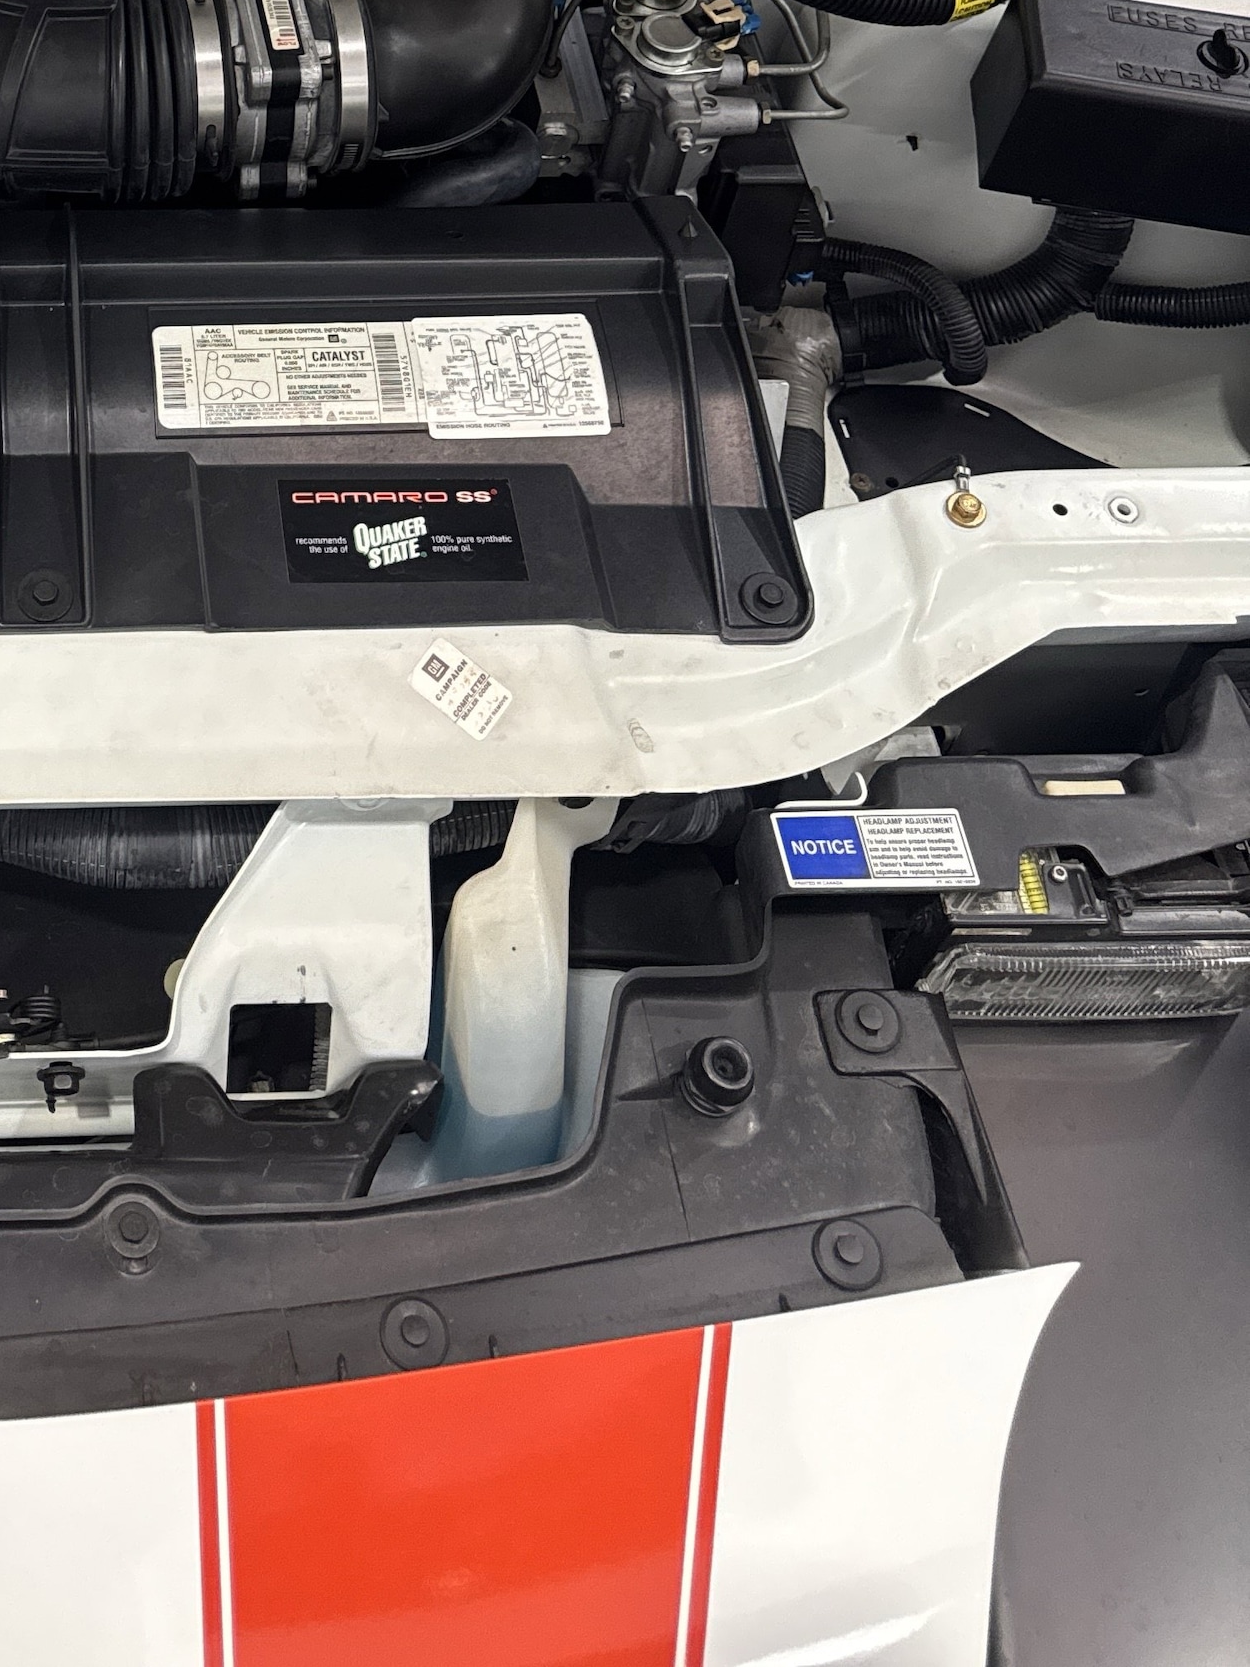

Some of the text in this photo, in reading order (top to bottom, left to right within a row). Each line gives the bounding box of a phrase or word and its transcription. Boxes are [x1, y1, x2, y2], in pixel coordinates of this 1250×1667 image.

[1111, 5, 1198, 32] FUSES
[1119, 63, 1222, 92] RELAYS
[312, 351, 365, 361] CATALYST
[292, 490, 492, 504] CAMARO SS
[295, 537, 348, 545] recommends
[353, 516, 428, 555] QUAKER
[431, 536, 513, 545] 100% pure synthetic
[309, 545, 322, 553] the
[339, 545, 348, 553] of
[368, 538, 421, 569] STATE
[432, 544, 472, 554] engine oil.
[427, 659, 442, 675] GM
[435, 659, 468, 701] CAMPAIGN
[453, 673, 486, 718] COMPLETED
[461, 681, 492, 721] DEALER CODE
[478, 695, 509, 734] DO NOT REMOVE
[905, 817, 953, 825] ADJUSTMENT
[791, 839, 857, 855] NOTICE
